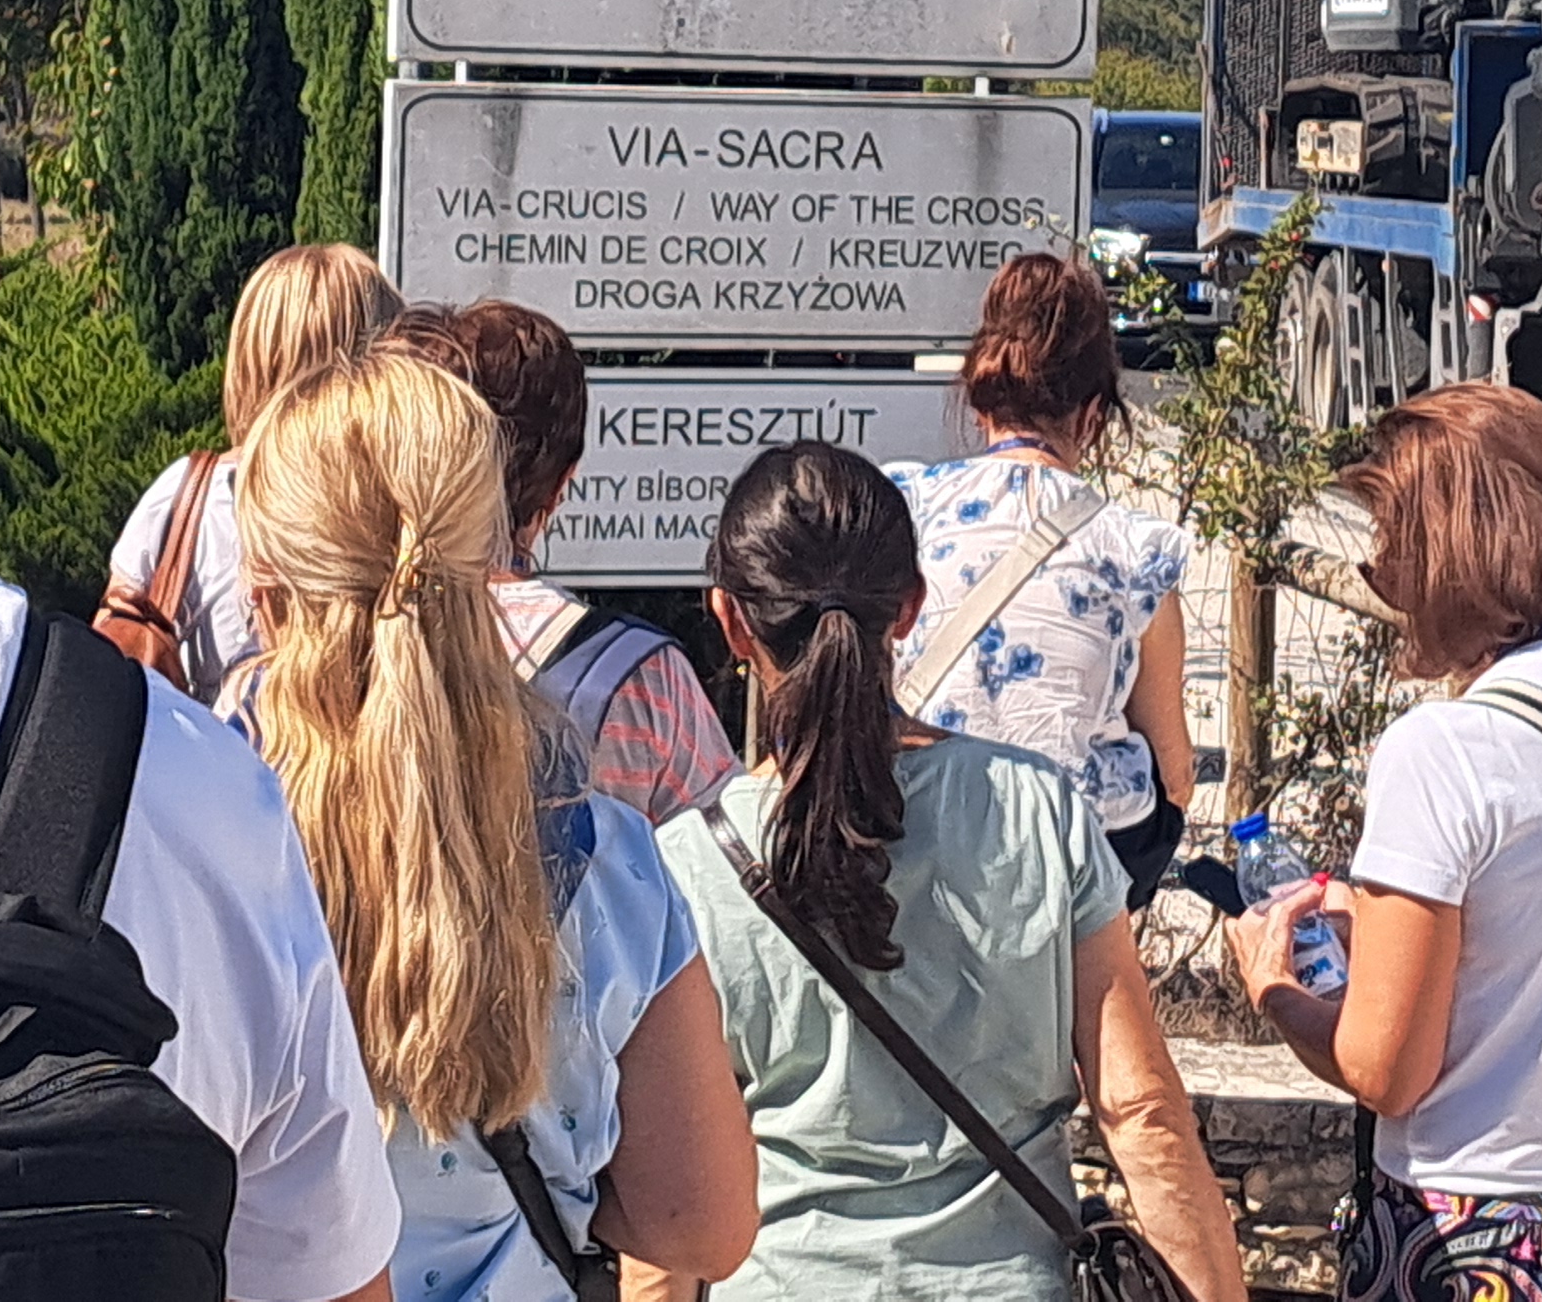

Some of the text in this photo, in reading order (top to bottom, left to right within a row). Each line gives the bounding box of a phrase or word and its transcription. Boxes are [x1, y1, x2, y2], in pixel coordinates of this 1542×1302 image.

[608, 126, 883, 171] VIA-SACRA
[437, 187, 648, 221] VIA-CRUCIS
[710, 192, 780, 222] WAY
[791, 194, 839, 223] OF
[849, 195, 915, 225] THE
[927, 196, 1045, 227] CROSS
[455, 233, 587, 265] CHEMIN
[601, 235, 647, 265] DE
[660, 236, 767, 267] CROIX
[574, 273, 906, 312] DROGA KRZYŻOWA
[599, 399, 877, 446] KERESZTÚT
[567, 468, 732, 502] NTY BÍBOR
[545, 514, 719, 541] ATIMAI MAG
